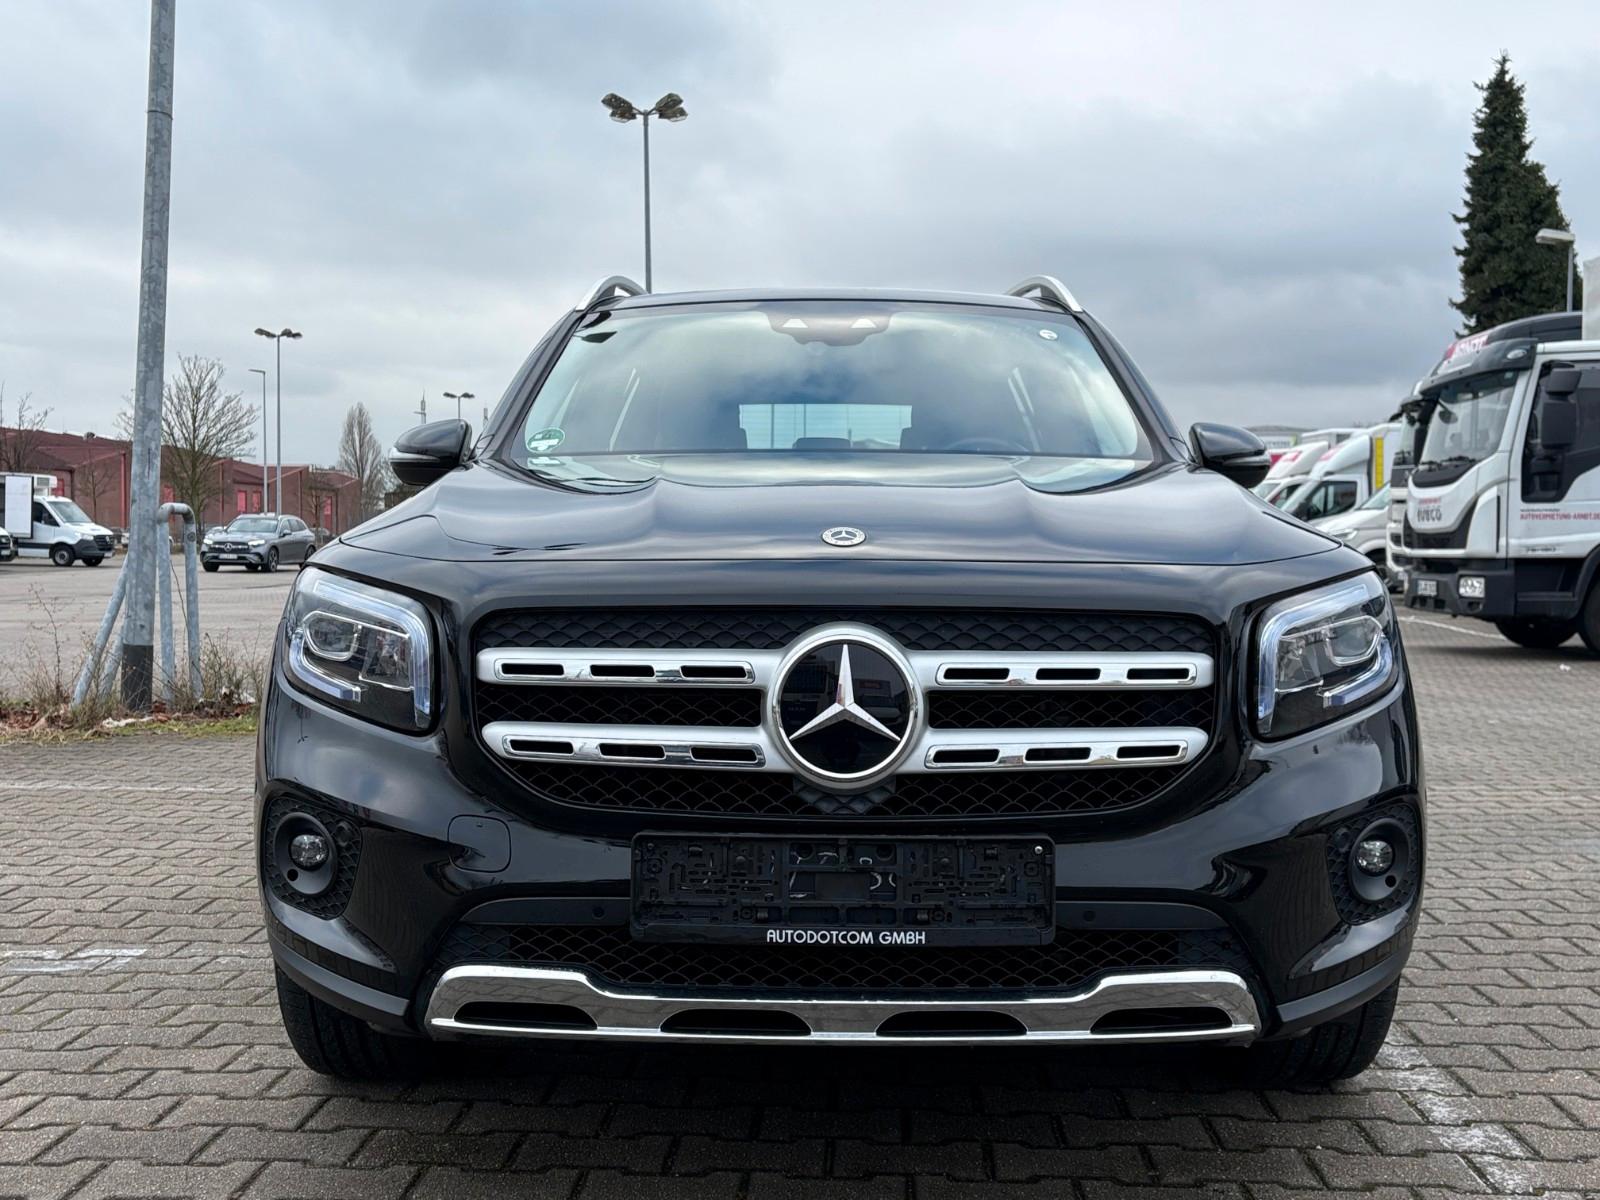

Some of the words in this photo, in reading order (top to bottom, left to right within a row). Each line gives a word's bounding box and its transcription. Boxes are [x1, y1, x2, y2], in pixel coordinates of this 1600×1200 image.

[1417, 508, 1442, 522] IVECO
[766, 929, 874, 944] AUTODOTCOM
[878, 931, 927, 945] GMBH
